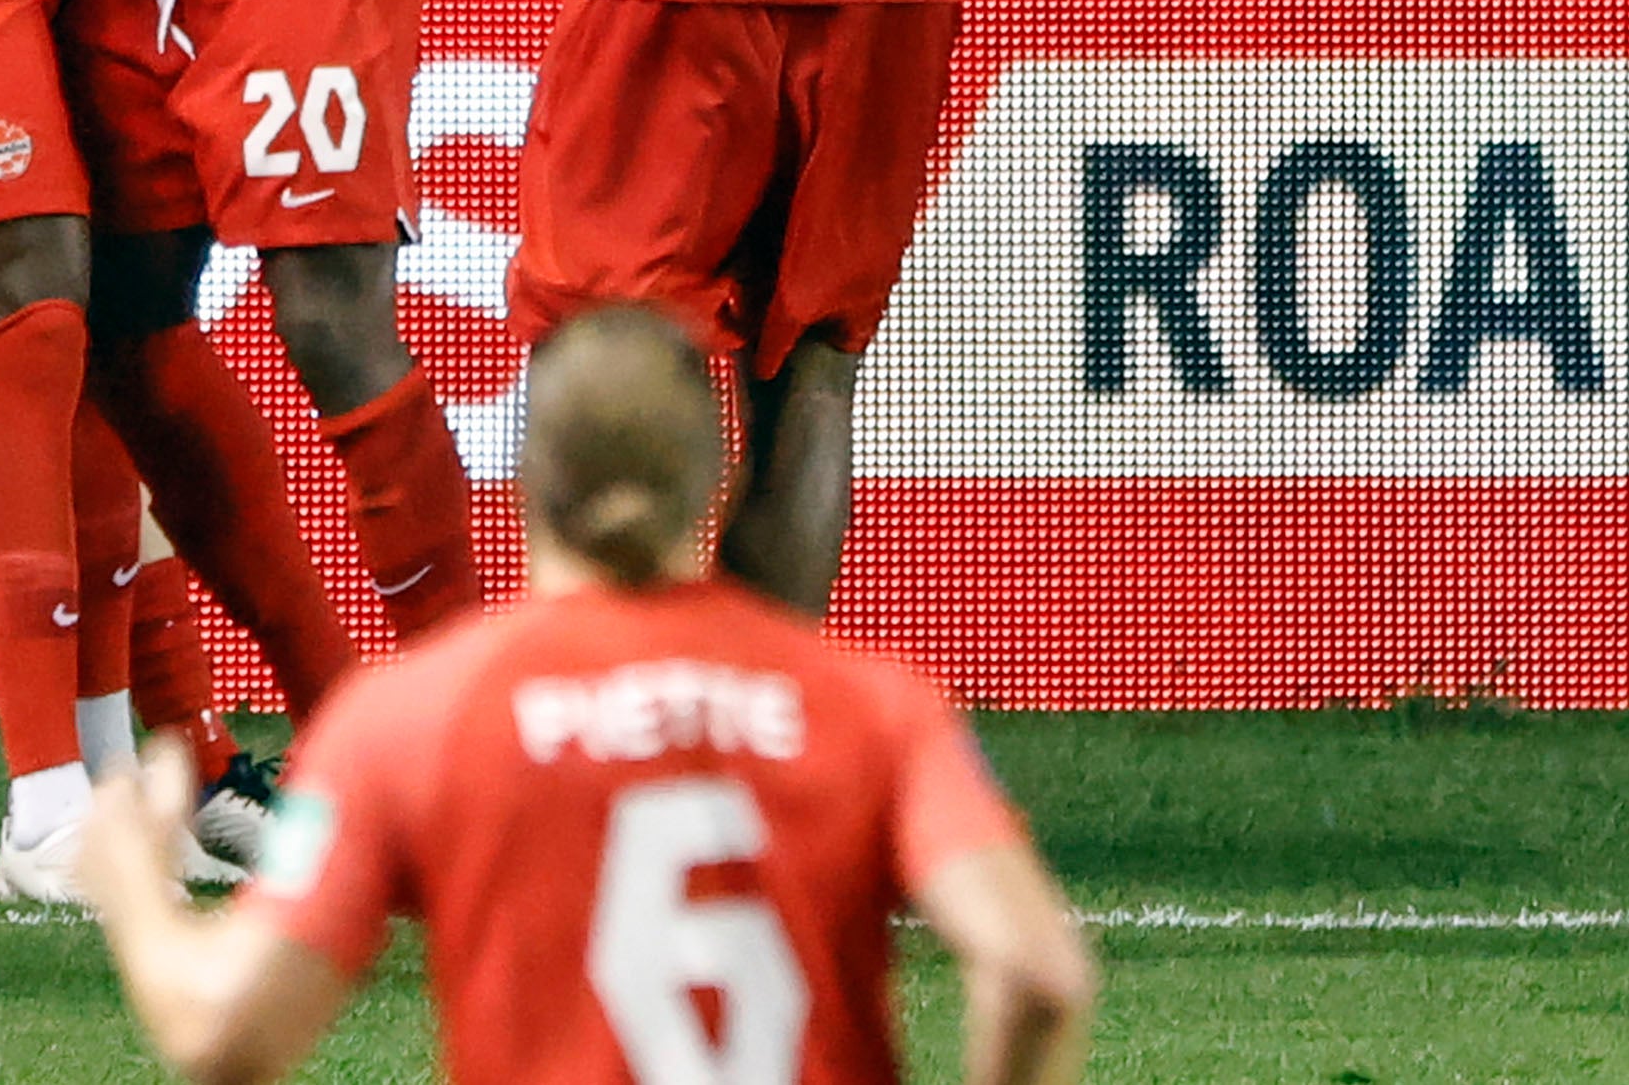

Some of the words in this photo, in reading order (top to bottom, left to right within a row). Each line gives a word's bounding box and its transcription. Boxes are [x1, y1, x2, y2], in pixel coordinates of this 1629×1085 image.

[243, 65, 367, 177] 20
[1082, 140, 1609, 398] ROA
[586, 776, 812, 1085] 6
